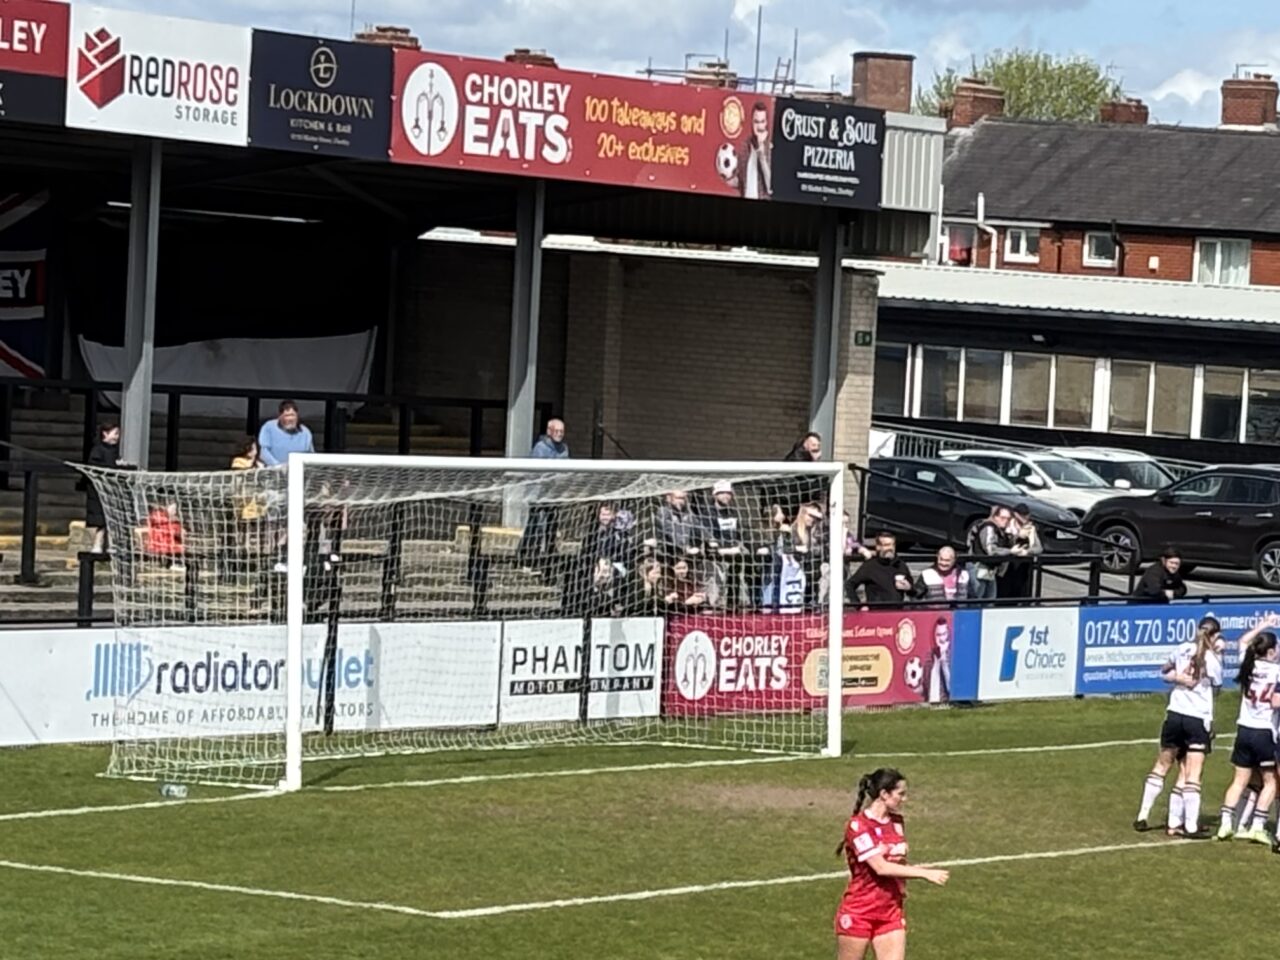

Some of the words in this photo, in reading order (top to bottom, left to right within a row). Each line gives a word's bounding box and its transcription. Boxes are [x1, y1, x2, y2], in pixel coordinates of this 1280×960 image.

[268, 83, 374, 119] LOCKDOWN
[464, 73, 571, 113] CHORLEY
[175, 105, 238, 126] STORAGE
[289, 118, 325, 131] KITCHEN
[328, 122, 333, 132] &
[336, 123, 352, 134] BAR
[585, 95, 609, 123] 100
[611, 96, 677, 134] Takeaways
[681, 108, 706, 136] and
[829, 118, 839, 140] &
[463, 104, 573, 164] EATS
[597, 132, 625, 158] 20+
[628, 136, 690, 166] exclusives
[803, 145, 855, 172] PIZZERIA
[1029, 627, 1049, 646] 1st
[1085, 620, 1129, 645] 01743
[1134, 619, 1163, 643] 770
[1166, 618, 1196, 642] 500
[720, 636, 790, 657] CHORLEY
[1024, 647, 1067, 670] Choice
[156, 650, 285, 695] radiator
[718, 656, 791, 692] EATS
[513, 680, 566, 694] MOTOR
[91, 711, 119, 728] THE
[176, 707, 195, 723] OF
